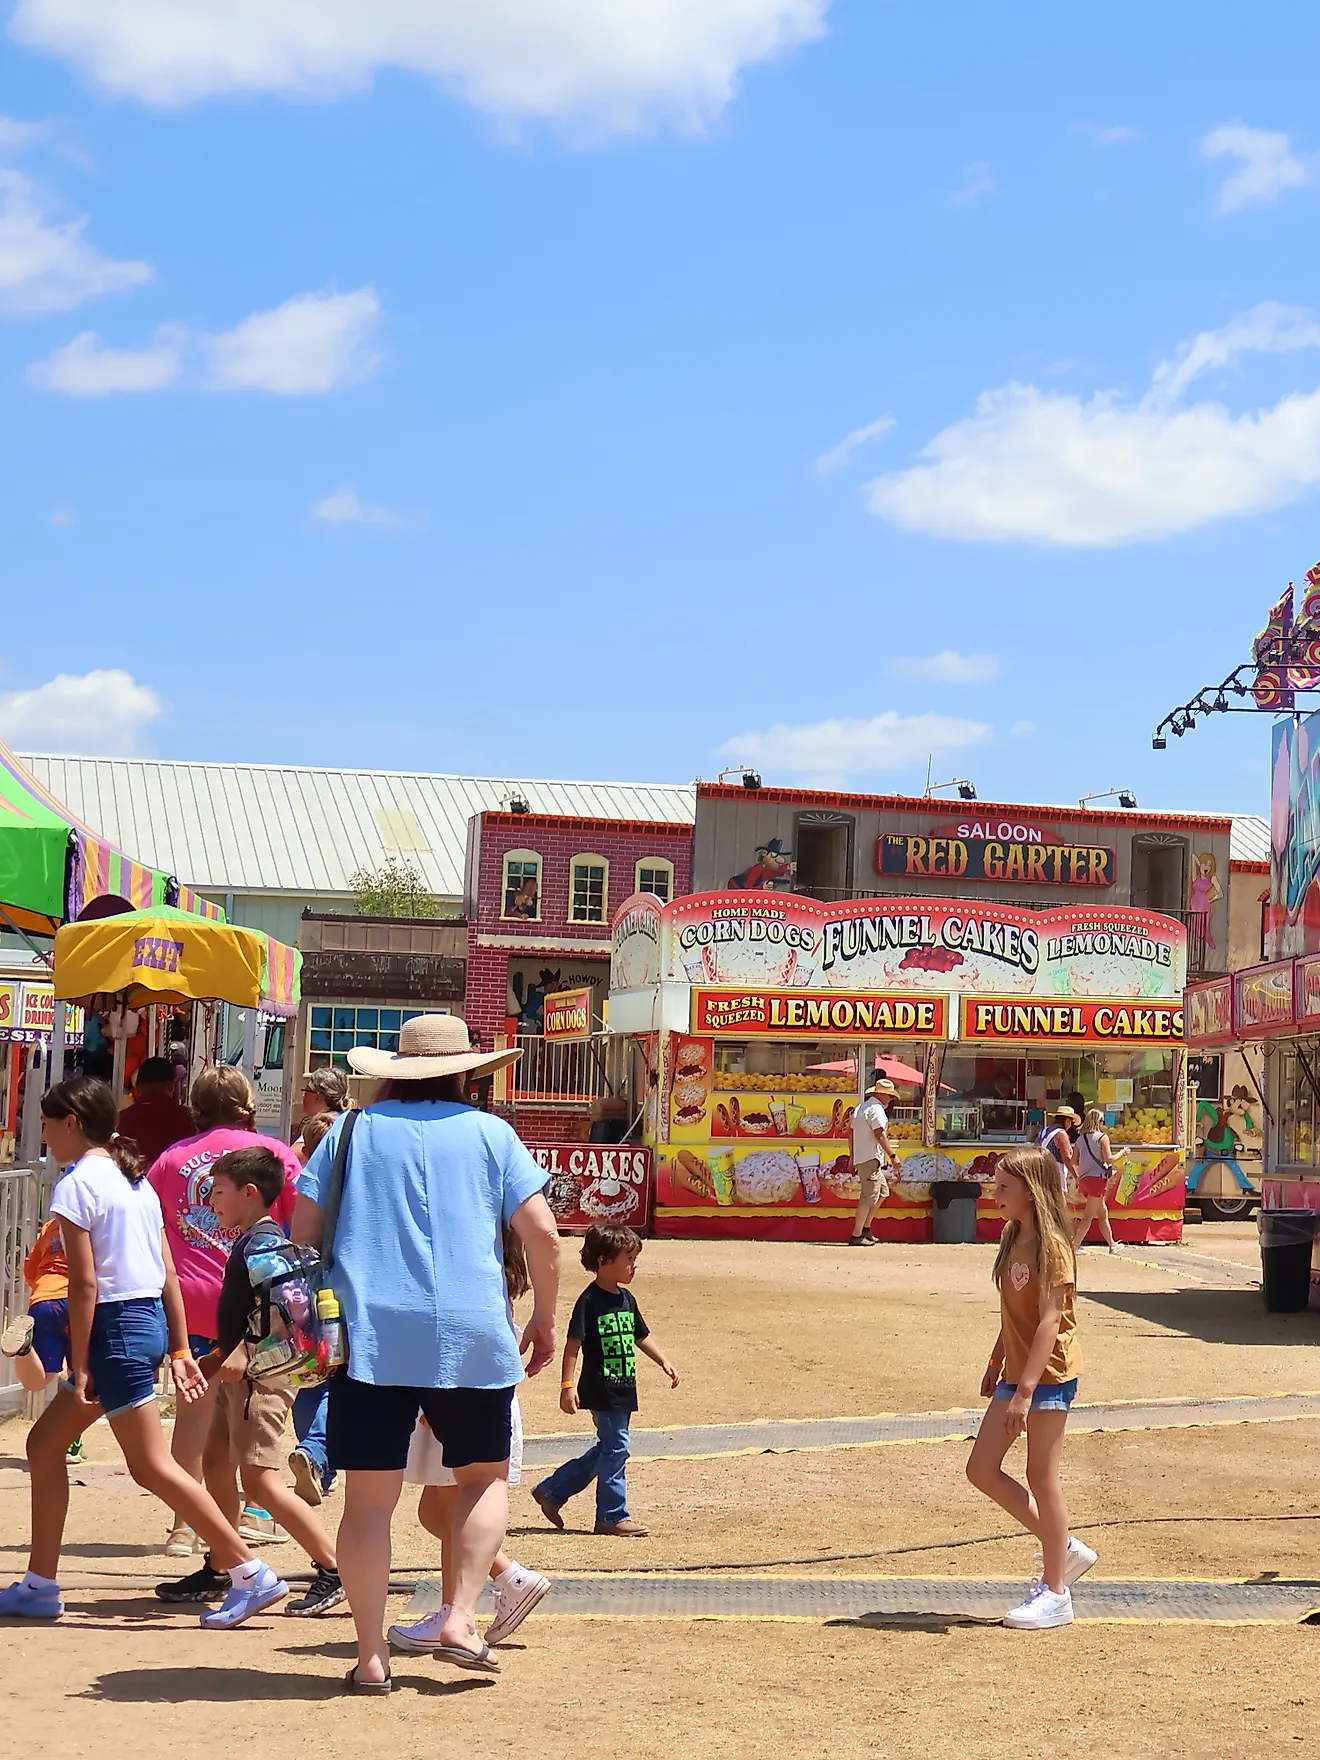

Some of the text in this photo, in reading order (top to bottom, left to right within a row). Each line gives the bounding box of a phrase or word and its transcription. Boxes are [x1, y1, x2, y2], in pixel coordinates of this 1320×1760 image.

[957, 822, 1042, 843] SALOON
[886, 835, 1109, 885] THE RED GARTER
[712, 908, 786, 920] HOME MADE
[680, 918, 815, 951] CORN DOGS
[1071, 922, 1149, 937] FRESH SQUEEZED
[132, 937, 185, 972] EXIT
[823, 915, 1040, 975] FUNNEL CAKES
[1047, 932, 1172, 967] LEMONADE
[568, 974, 604, 987] HOWDY
[26, 994, 38, 1008] ICE
[40, 995, 56, 1009] COL
[707, 996, 765, 1012] FRESH
[25, 1010, 55, 1026] DRINK
[546, 1008, 586, 1032] CORN DOGS
[705, 1010, 766, 1028] SQUEEZED
[769, 998, 934, 1031] LEMONADE
[976, 1004, 1184, 1037] FUNNEL CAKES
[569, 1150, 645, 1184] CAKES
